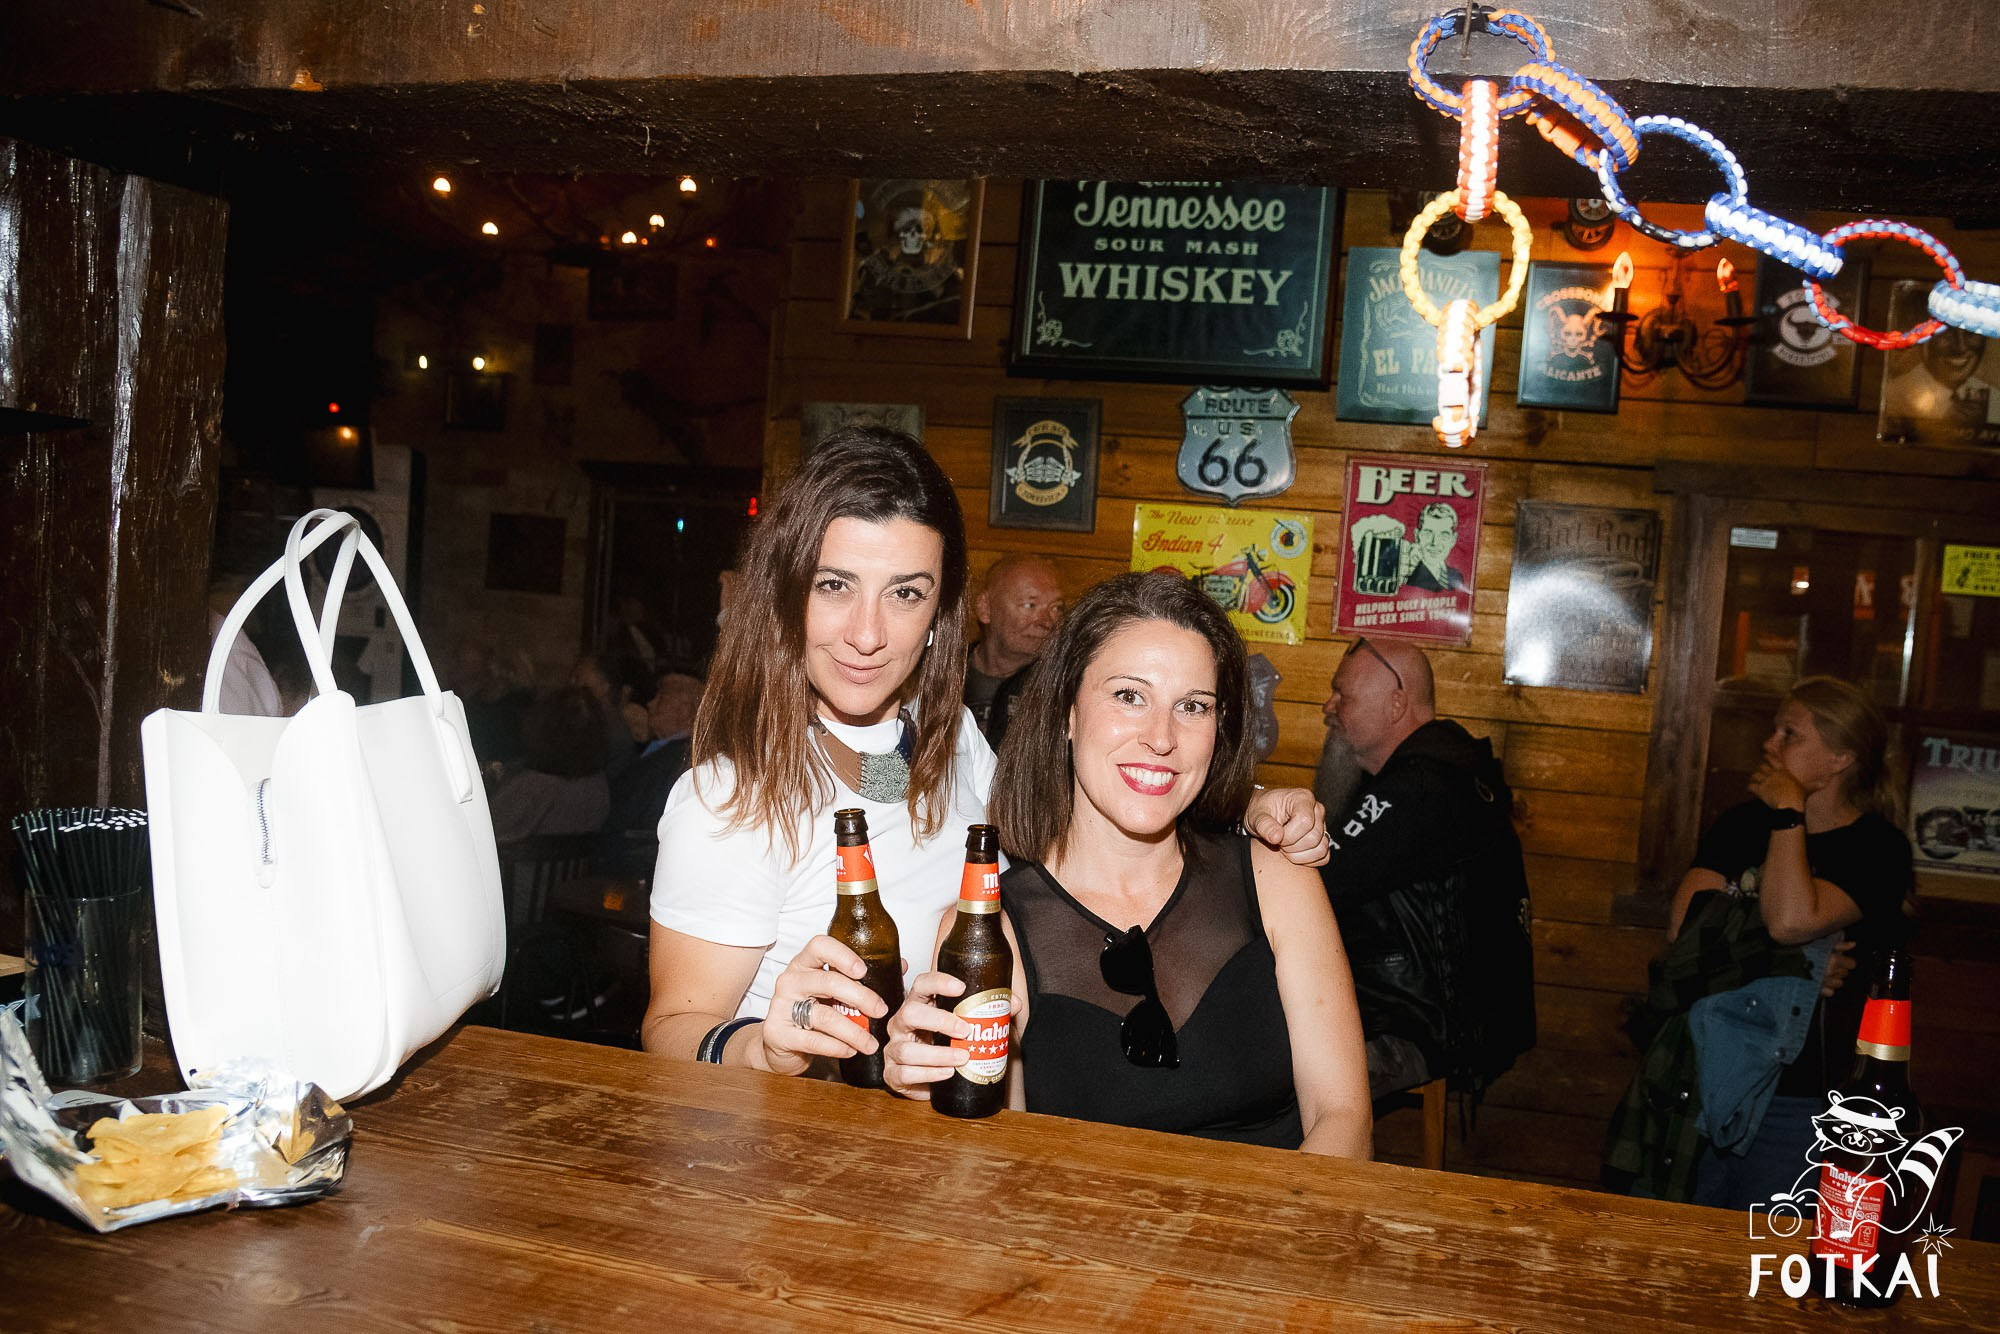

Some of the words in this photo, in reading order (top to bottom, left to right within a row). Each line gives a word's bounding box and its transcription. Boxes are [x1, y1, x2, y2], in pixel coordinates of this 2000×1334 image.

[1073, 181, 1286, 232] Tennessee
[1094, 238, 1164, 252] SOUR
[1186, 240, 1259, 255] MASH
[1058, 262, 1293, 306] WHISKEY
[1372, 348, 1399, 377] EL
[1204, 398, 1271, 414] ROUTE
[1198, 438, 1267, 487] 66
[1356, 465, 1475, 504] BEER
[1167, 511, 1202, 525] New
[1142, 530, 1203, 553] Indian
[1208, 533, 1225, 556] 4
[1354, 614, 1378, 627] HAVE
[1380, 613, 1398, 625] SEX
[1400, 610, 1426, 623] SINCE
[1355, 601, 1395, 615] HELPING
[1396, 599, 1419, 612] UGLY
[1420, 596, 1457, 609] PEOPLE
